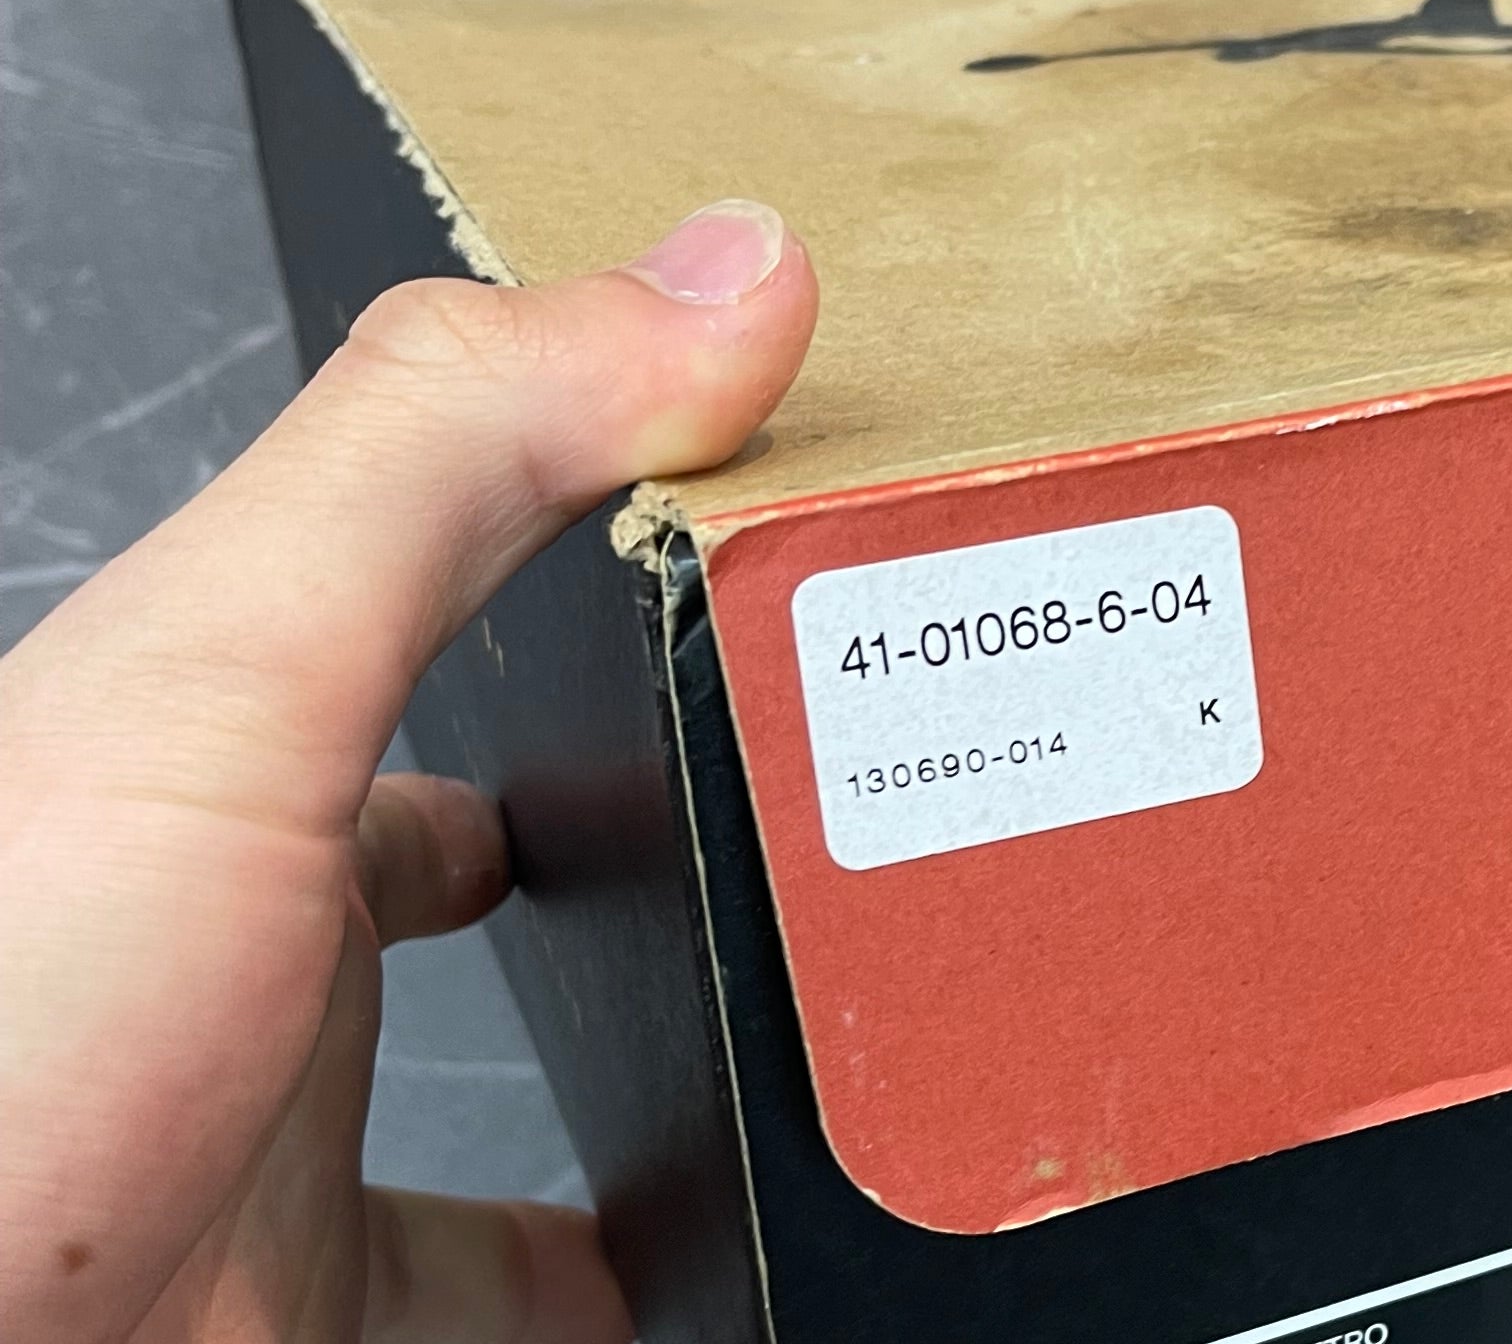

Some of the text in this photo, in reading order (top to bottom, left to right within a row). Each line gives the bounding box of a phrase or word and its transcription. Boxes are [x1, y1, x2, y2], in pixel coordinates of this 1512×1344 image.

[841, 574, 1211, 679] 41-01068-6-04
[1199, 698, 1222, 725] K
[847, 731, 1068, 798] 130690-014
